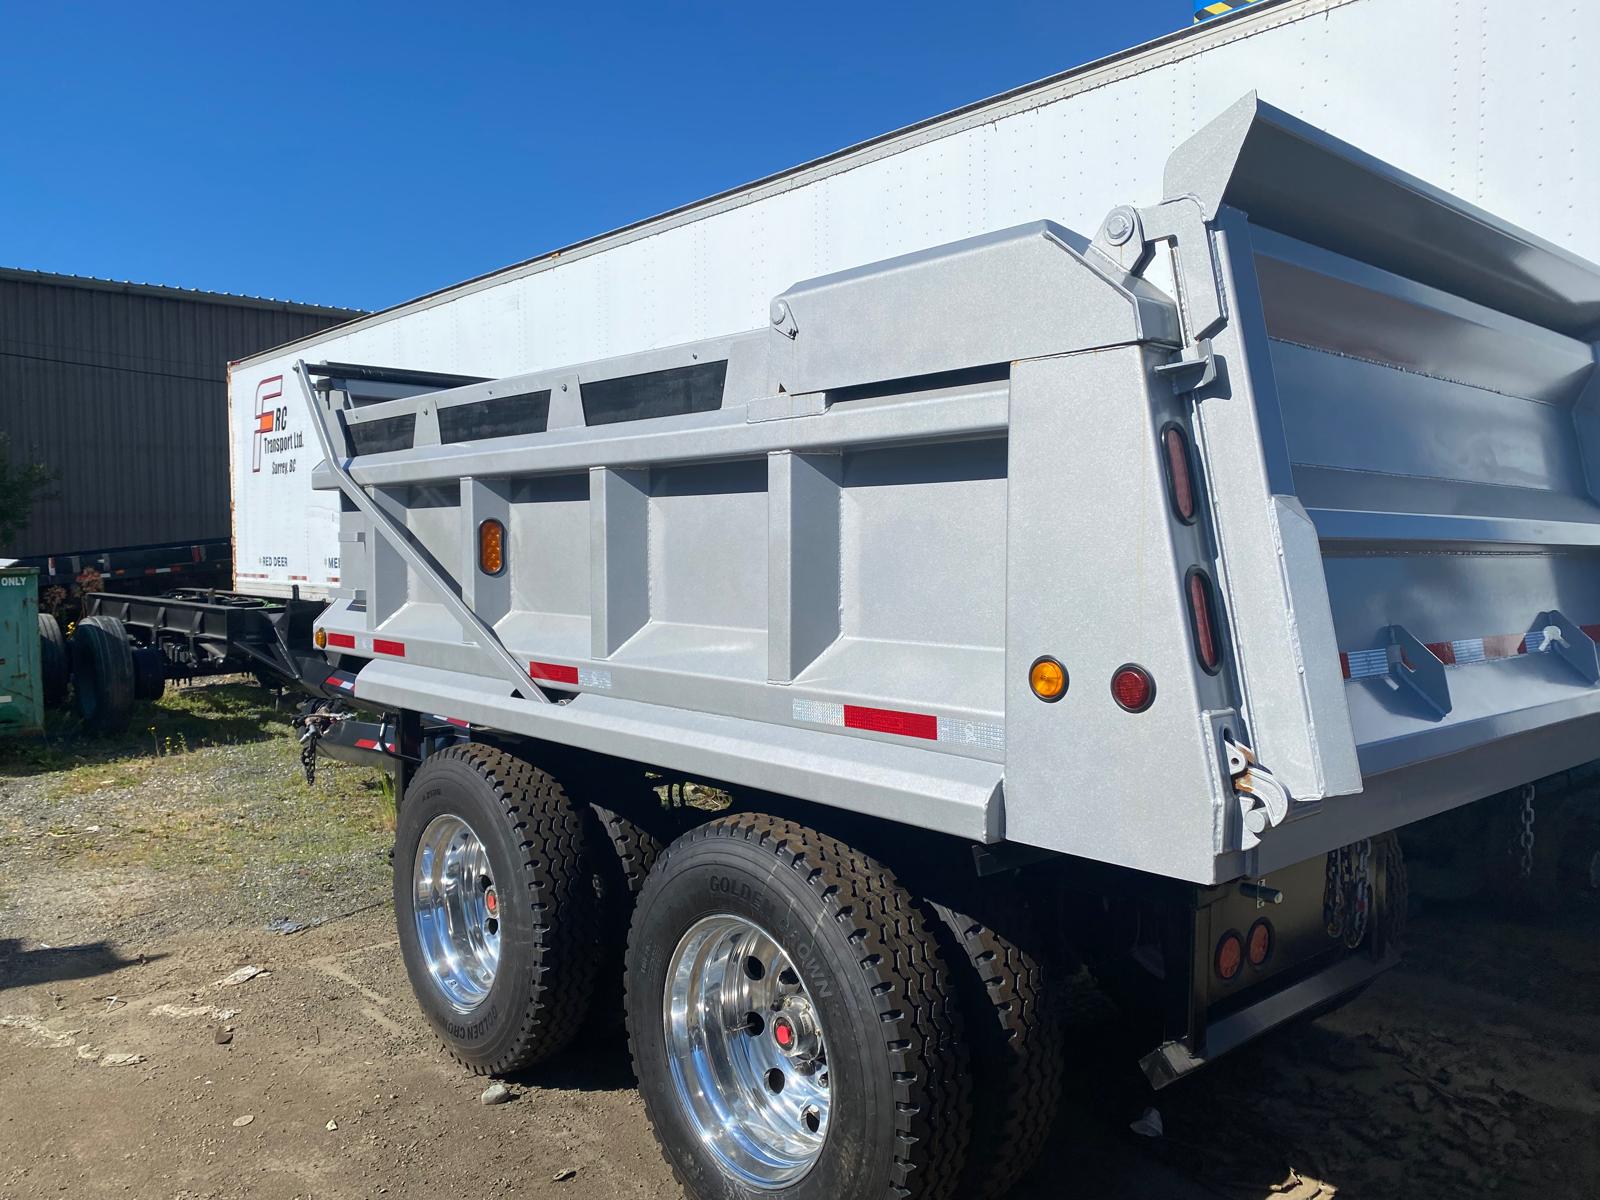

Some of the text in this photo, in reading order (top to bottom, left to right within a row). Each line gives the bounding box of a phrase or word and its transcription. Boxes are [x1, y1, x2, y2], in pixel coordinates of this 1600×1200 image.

[264, 434, 293, 454] Transport
[289, 458, 296, 473] BC
[262, 556, 288, 567] RED DEER
[1, 577, 26, 586] ONLY
[779, 915, 833, 998] COWN
[467, 1004, 498, 1041] GOLDEN
